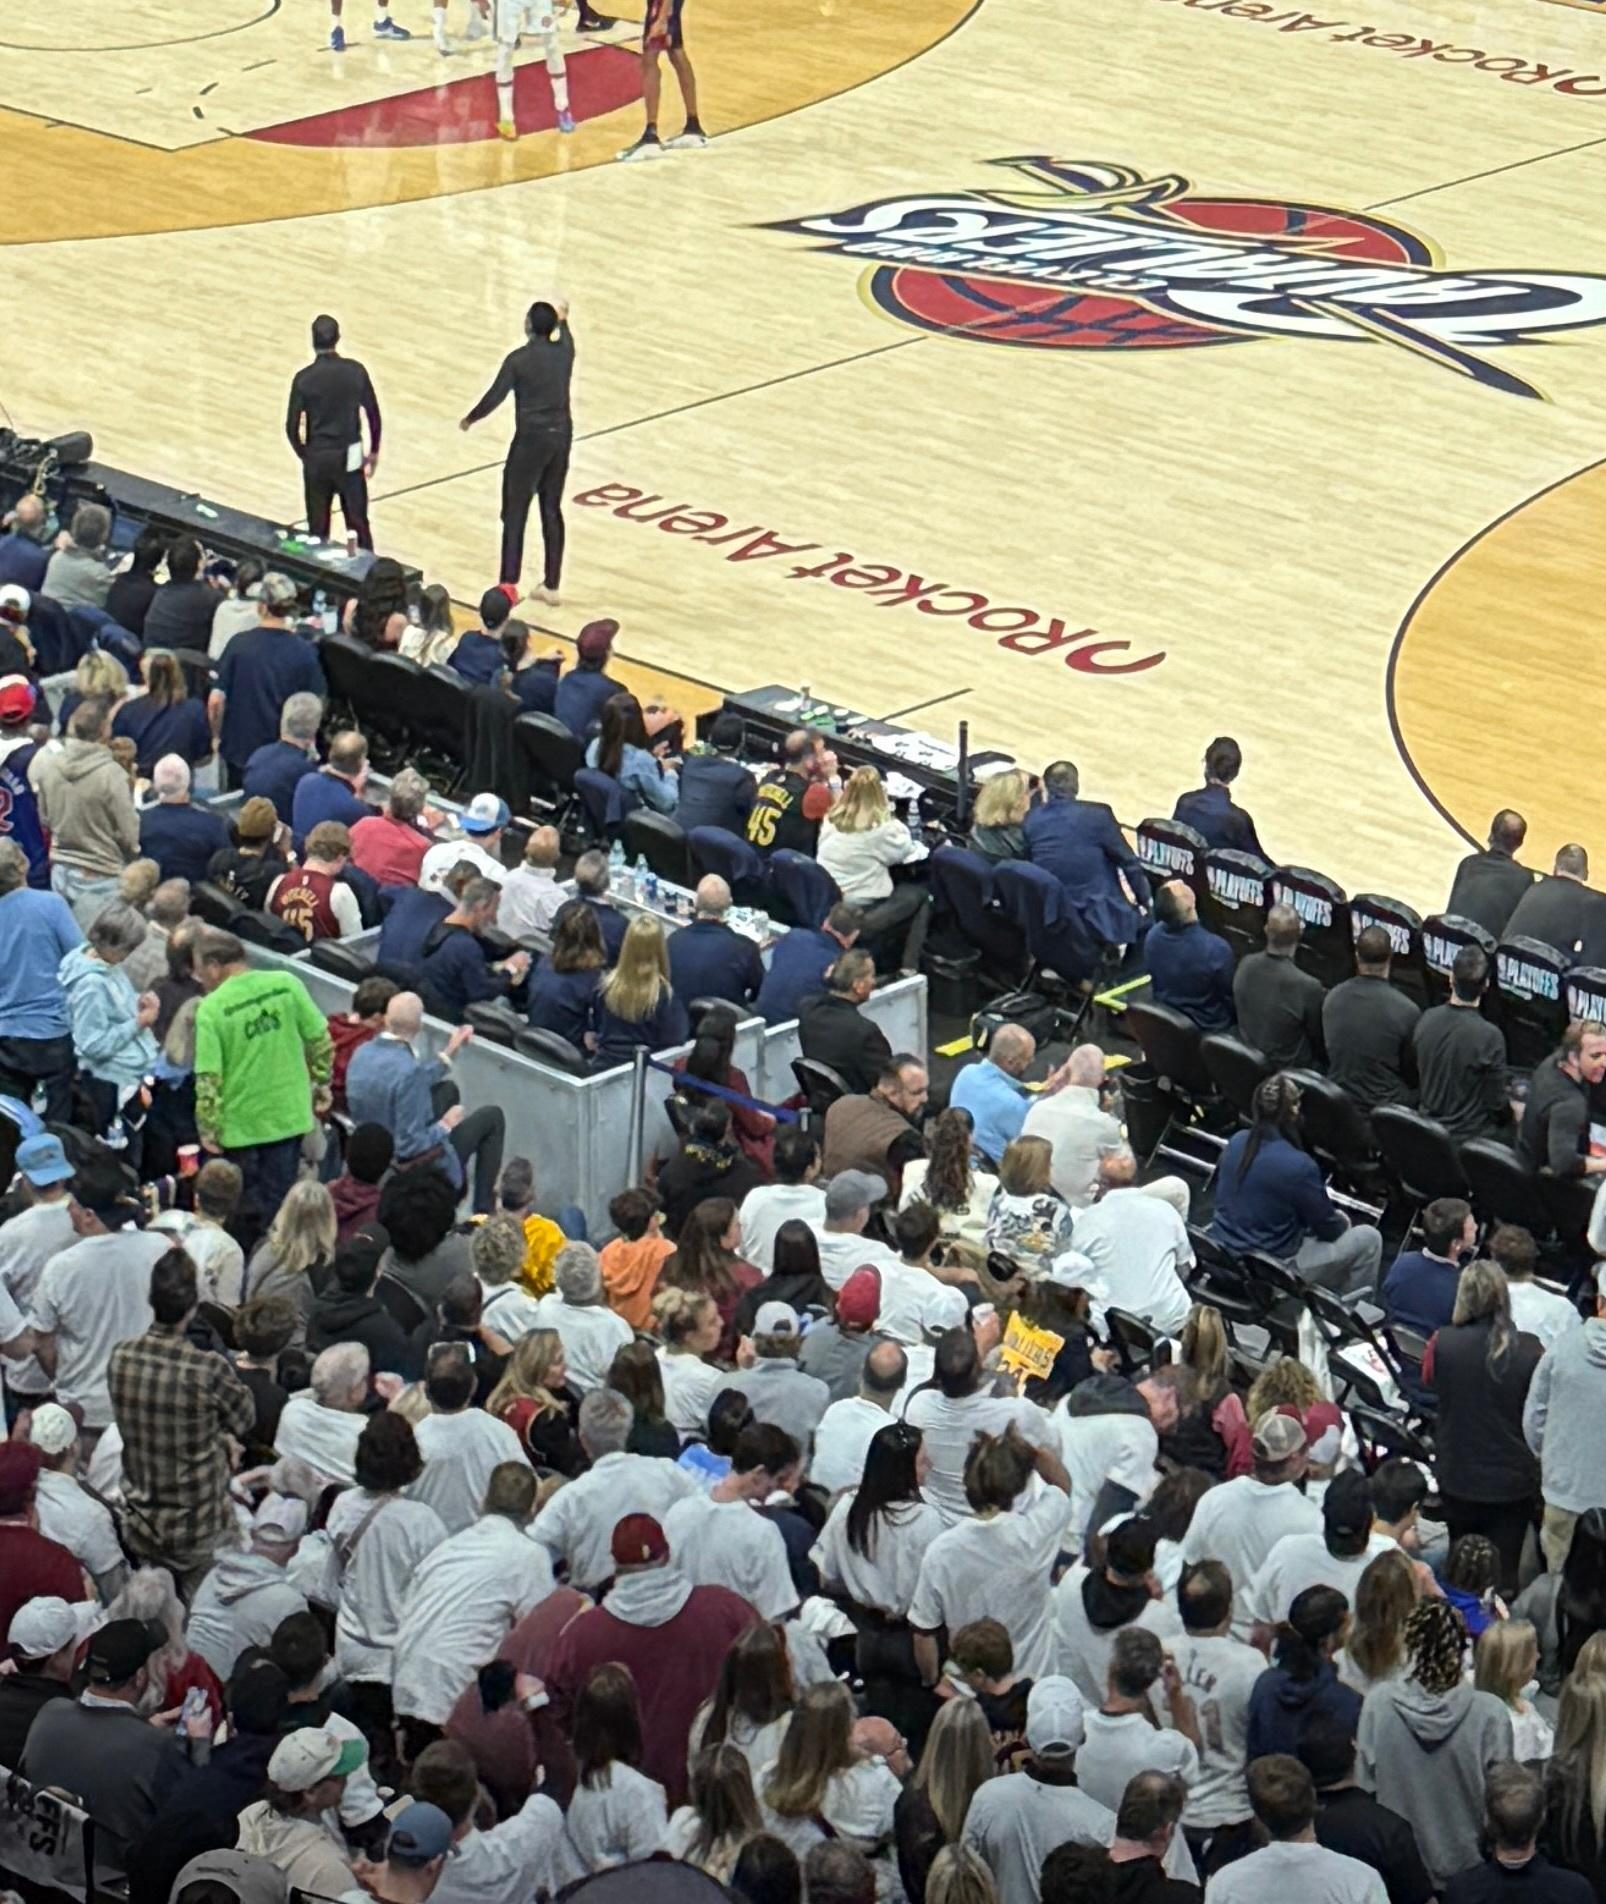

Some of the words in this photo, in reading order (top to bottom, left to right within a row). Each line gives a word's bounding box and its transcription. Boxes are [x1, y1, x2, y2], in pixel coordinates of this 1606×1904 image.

[1330, 25, 1575, 87] Rocket
[571, 481, 823, 563] Arena
[786, 551, 1099, 656] Rocket
[746, 805, 783, 847] 45
[1507, 958, 1559, 1001] PLAYOFFS
